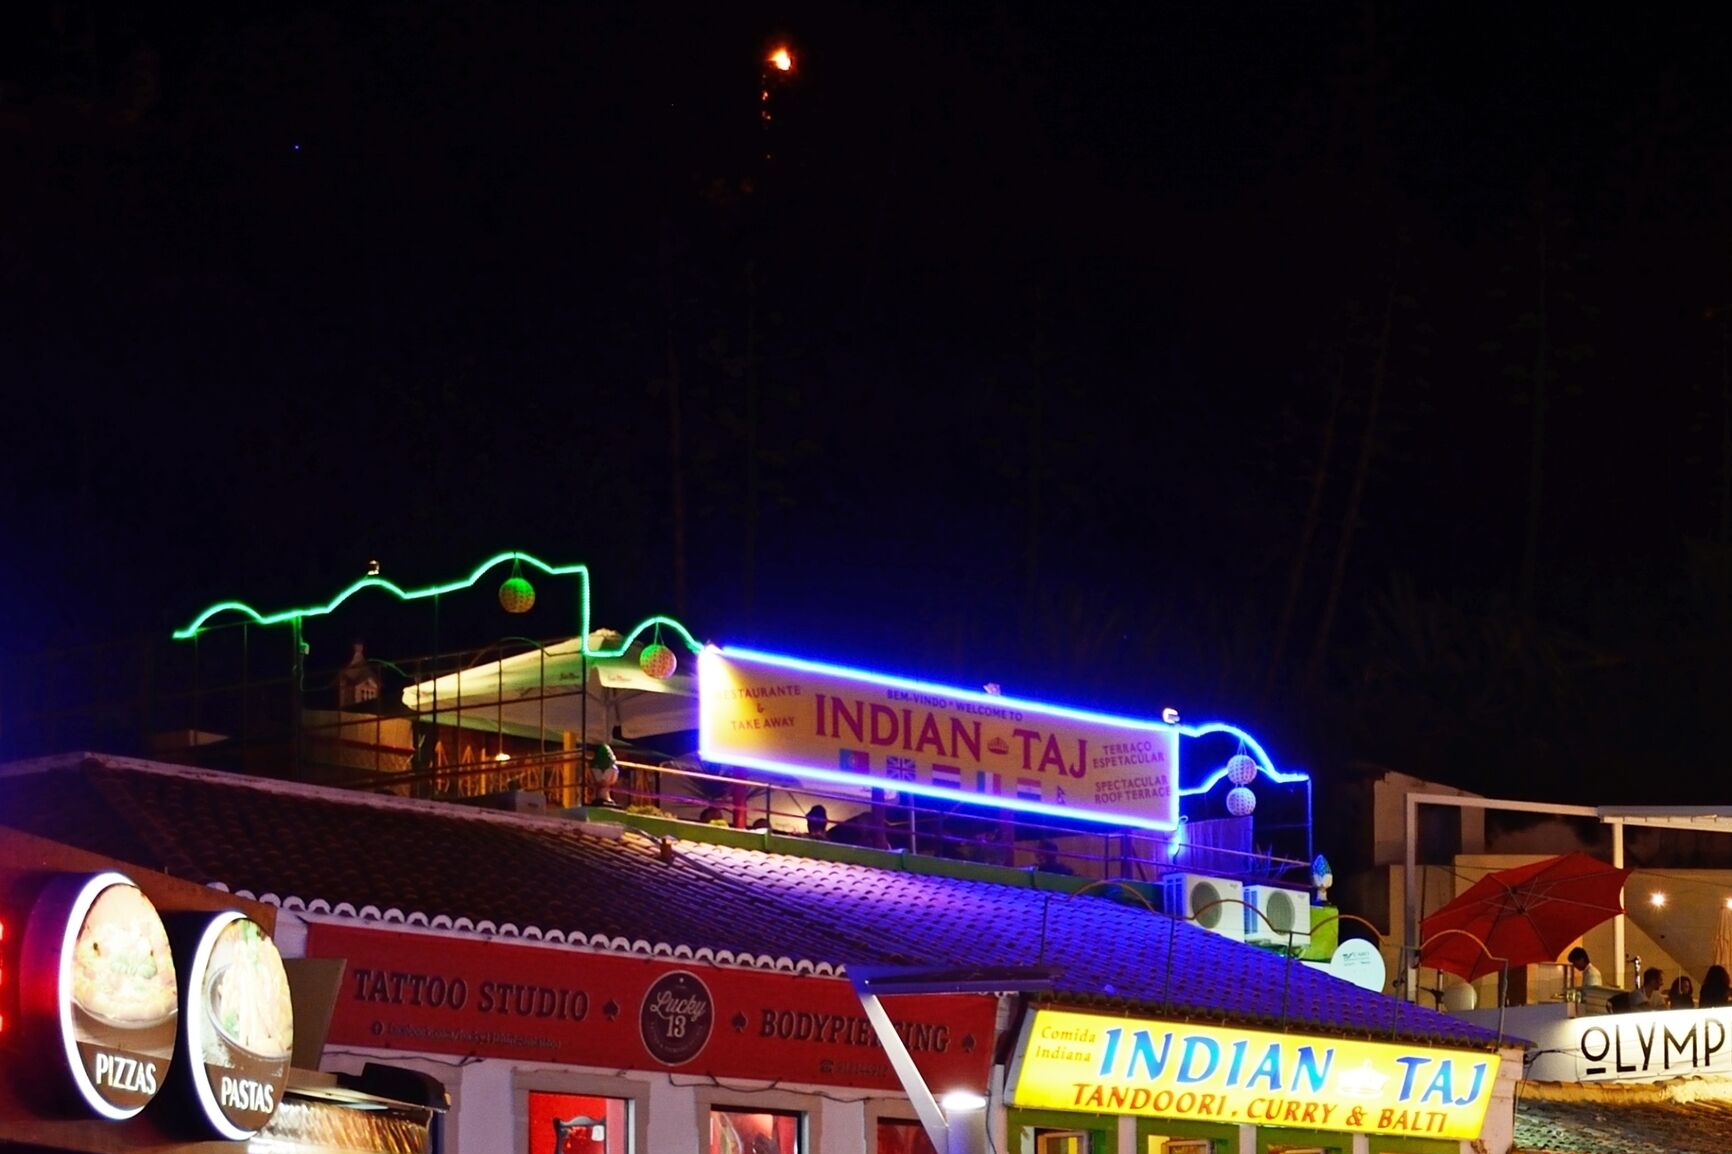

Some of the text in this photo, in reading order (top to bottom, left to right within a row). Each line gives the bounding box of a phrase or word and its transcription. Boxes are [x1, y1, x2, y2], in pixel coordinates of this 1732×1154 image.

[886, 689, 1023, 722] BEM-VINDO WELCOME TO
[731, 716, 796, 731] TAKE AWAY
[815, 693, 1089, 779] INDIAN TAJ
[1092, 752, 1165, 769] ESPETACULAR
[1094, 787, 1170, 804] ROOF TERRACE
[1095, 775, 1168, 792] SPECTACULAR
[353, 968, 591, 1022] TATTOO STUDIO
[649, 990, 707, 1023] Lucky
[665, 1014, 686, 1038] 13
[1040, 1026, 1096, 1043] Comida
[1035, 1045, 1092, 1062] Indiana
[1099, 1028, 1487, 1106] INDIAN TAJ
[95, 1053, 157, 1095] PIZZAS
[221, 1076, 274, 1114] PASTAS
[1247, 1097, 1338, 1124] CURRY
[1345, 1105, 1368, 1127] &
[1377, 1108, 1448, 1133] BALTI
